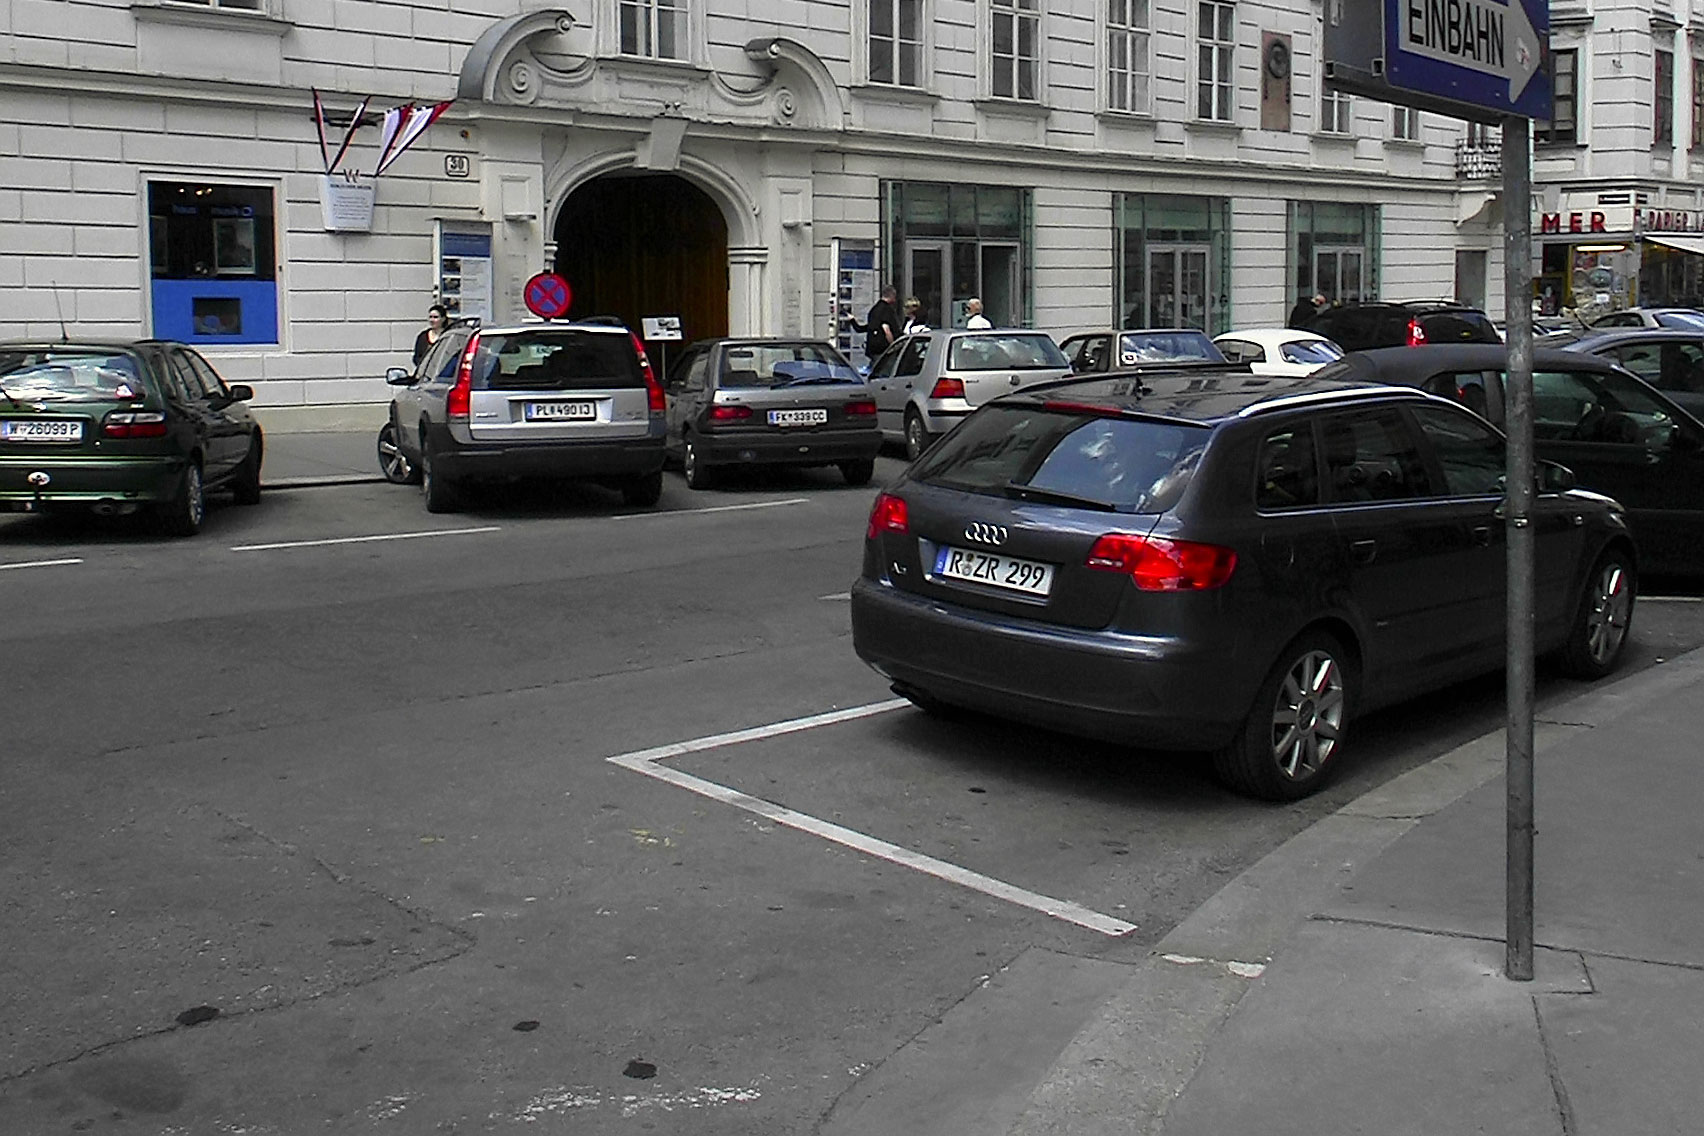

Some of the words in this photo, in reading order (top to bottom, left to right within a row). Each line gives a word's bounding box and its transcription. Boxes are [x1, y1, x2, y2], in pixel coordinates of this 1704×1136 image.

[536, 404, 549, 416] PL
[776, 412, 787, 422] FK
[949, 550, 964, 574] R
[973, 554, 1001, 582] ZR
[1005, 561, 1046, 589] 299
